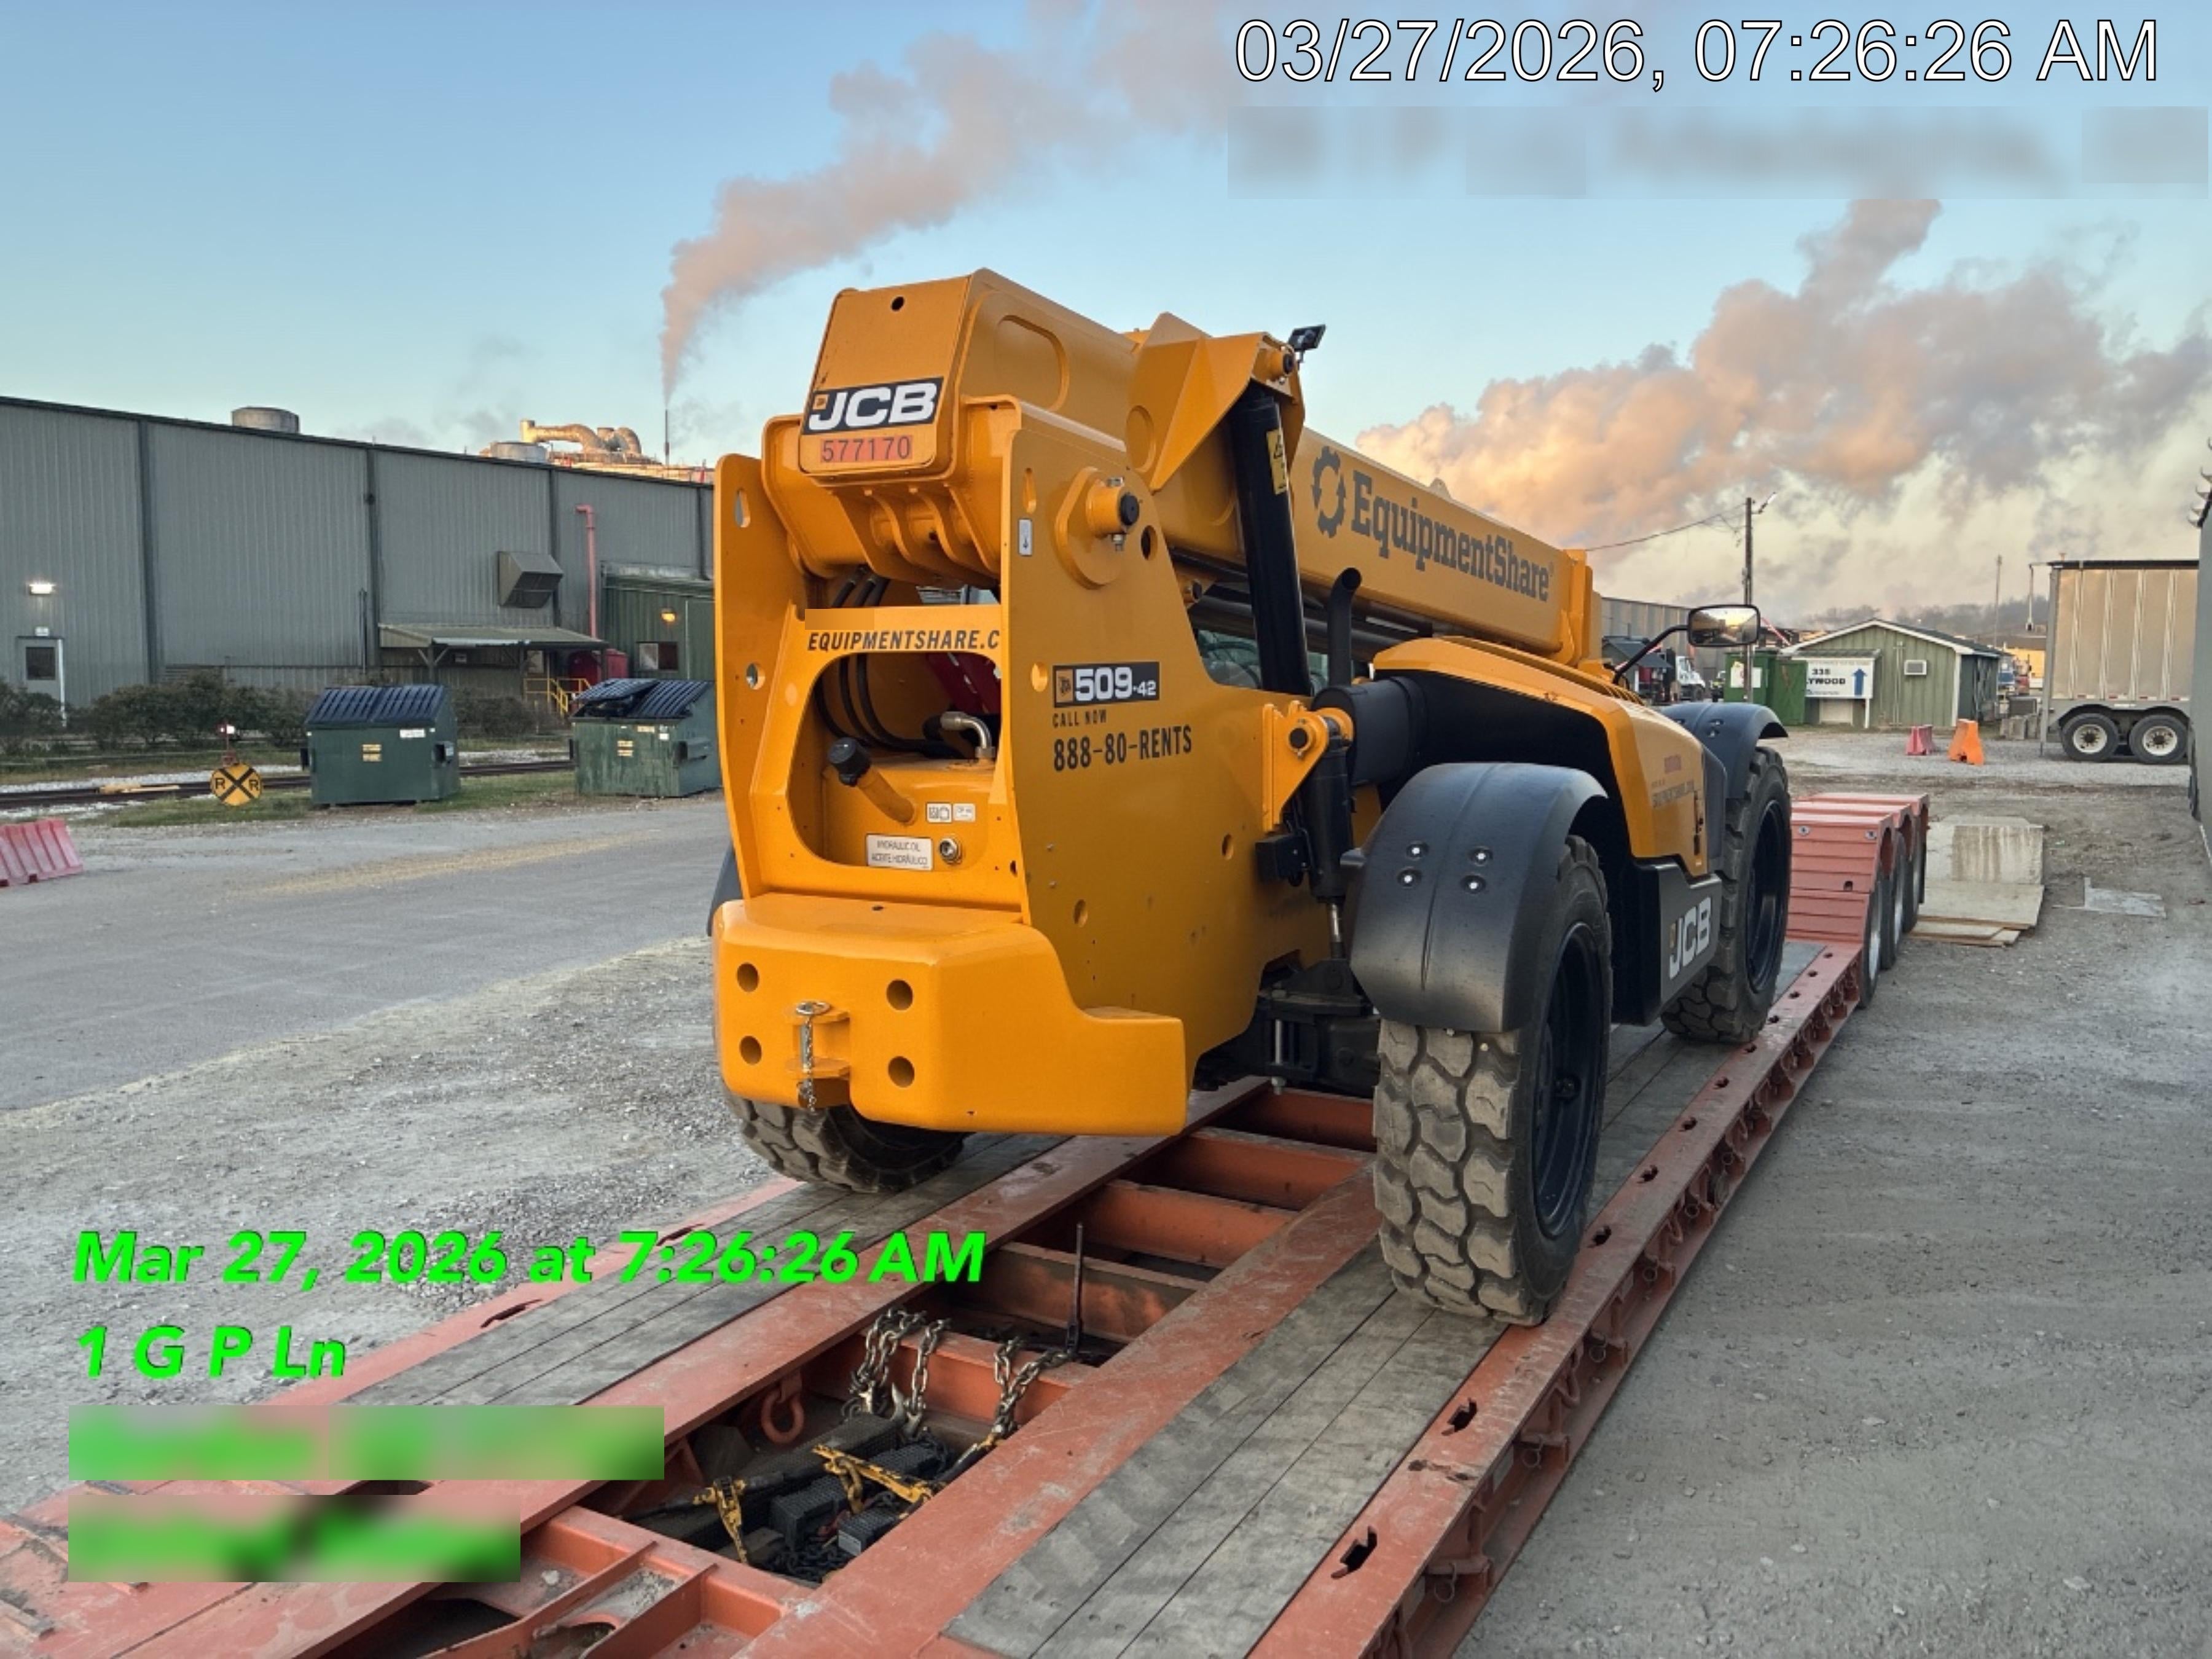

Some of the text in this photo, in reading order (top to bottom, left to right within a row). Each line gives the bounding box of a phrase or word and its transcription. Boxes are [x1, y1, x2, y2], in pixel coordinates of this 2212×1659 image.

[809, 383, 937, 430] JCB
[822, 436, 910, 461] 577170
[1351, 469, 1550, 602] EquipmentShare
[1053, 709, 1107, 728] CALL NOW
[1054, 724, 1191, 771] 888-80-RENTS
[1669, 897, 1711, 980] JCB
